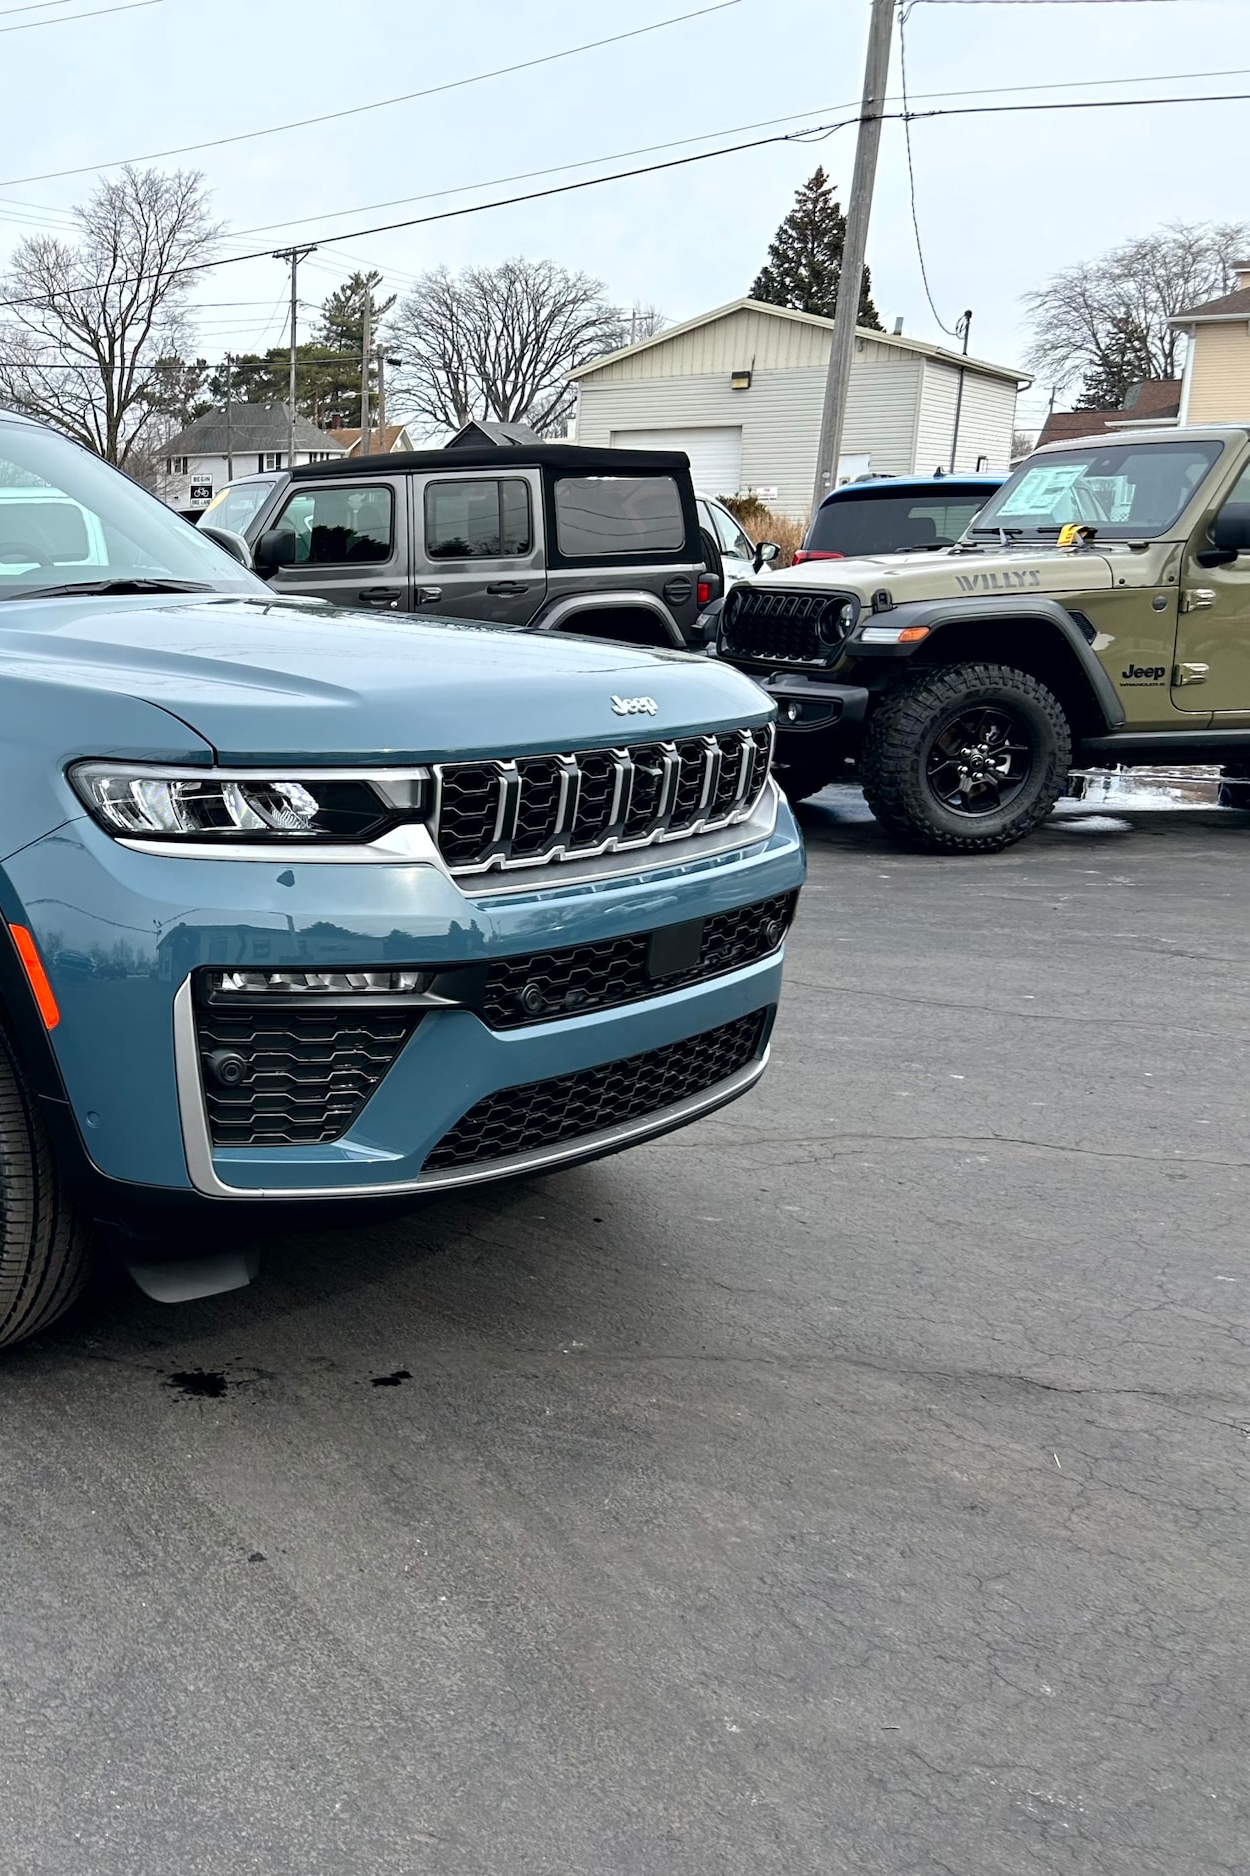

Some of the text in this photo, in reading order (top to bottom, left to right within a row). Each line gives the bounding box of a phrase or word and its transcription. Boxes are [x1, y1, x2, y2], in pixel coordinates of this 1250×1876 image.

[955, 570, 1040, 591] WILLYS
[1122, 664, 1165, 680] Jeep
[610, 695, 658, 716] Jeep
